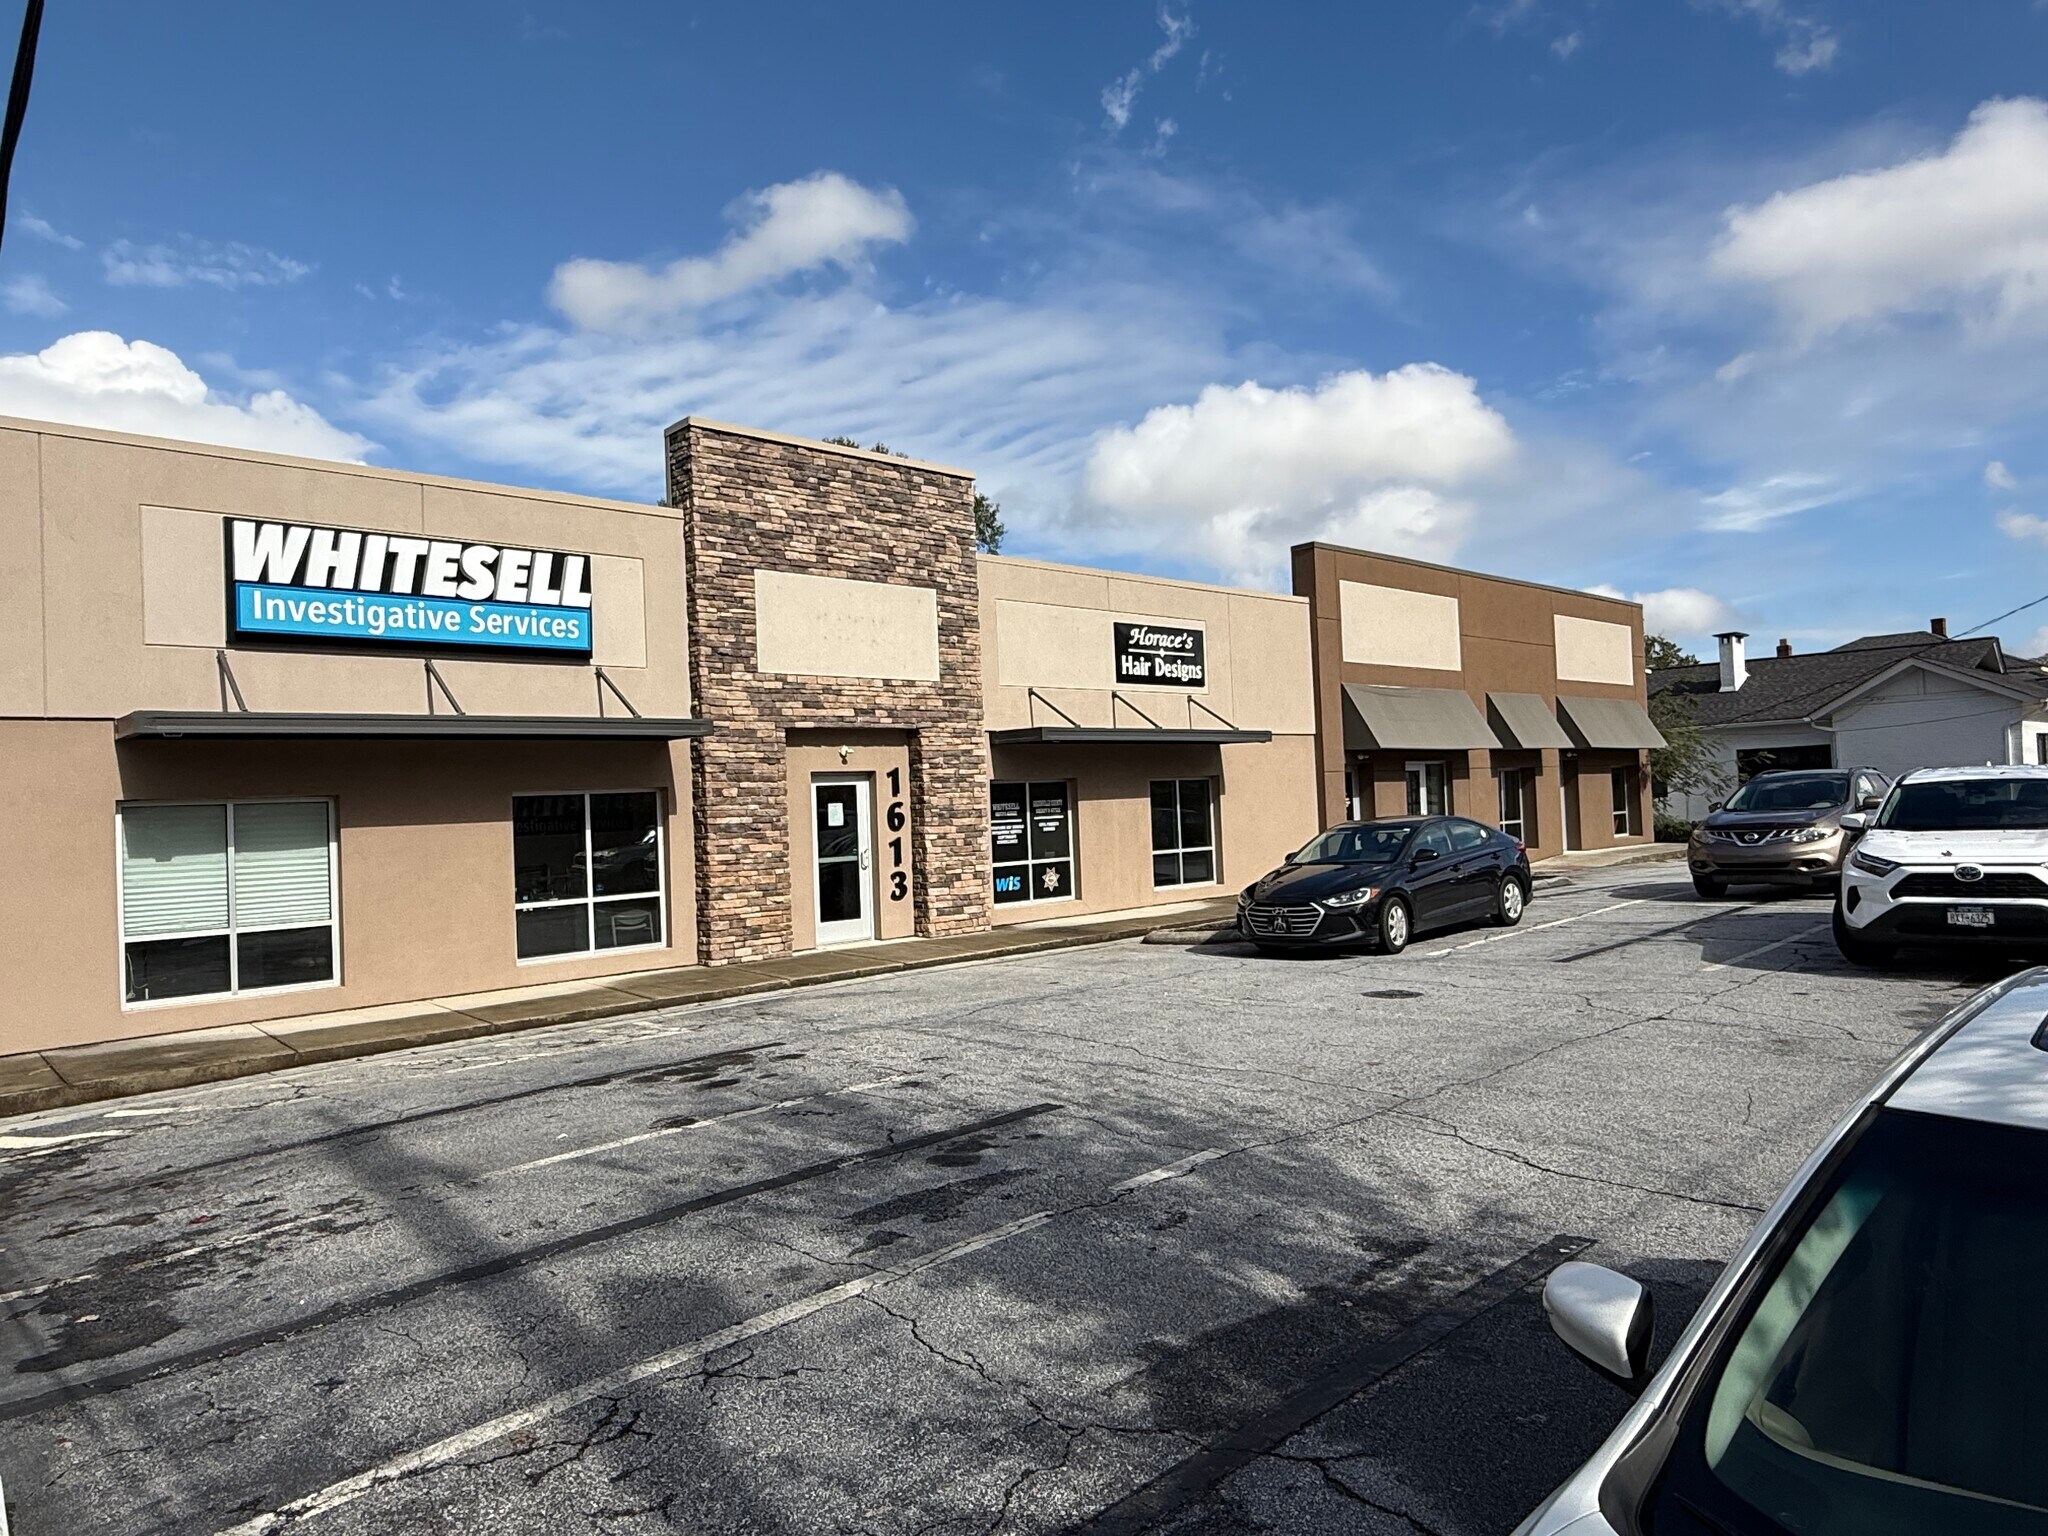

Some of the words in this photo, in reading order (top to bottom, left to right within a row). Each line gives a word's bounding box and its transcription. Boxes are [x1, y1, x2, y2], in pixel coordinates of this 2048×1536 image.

[232, 519, 592, 608] WHITESELL
[252, 590, 461, 634] Investigative
[468, 605, 580, 639] Services
[1128, 626, 1194, 650] Horace's
[1121, 654, 1152, 676] Hair
[1154, 657, 1203, 682] Designs
[886, 766, 909, 902] 1613
